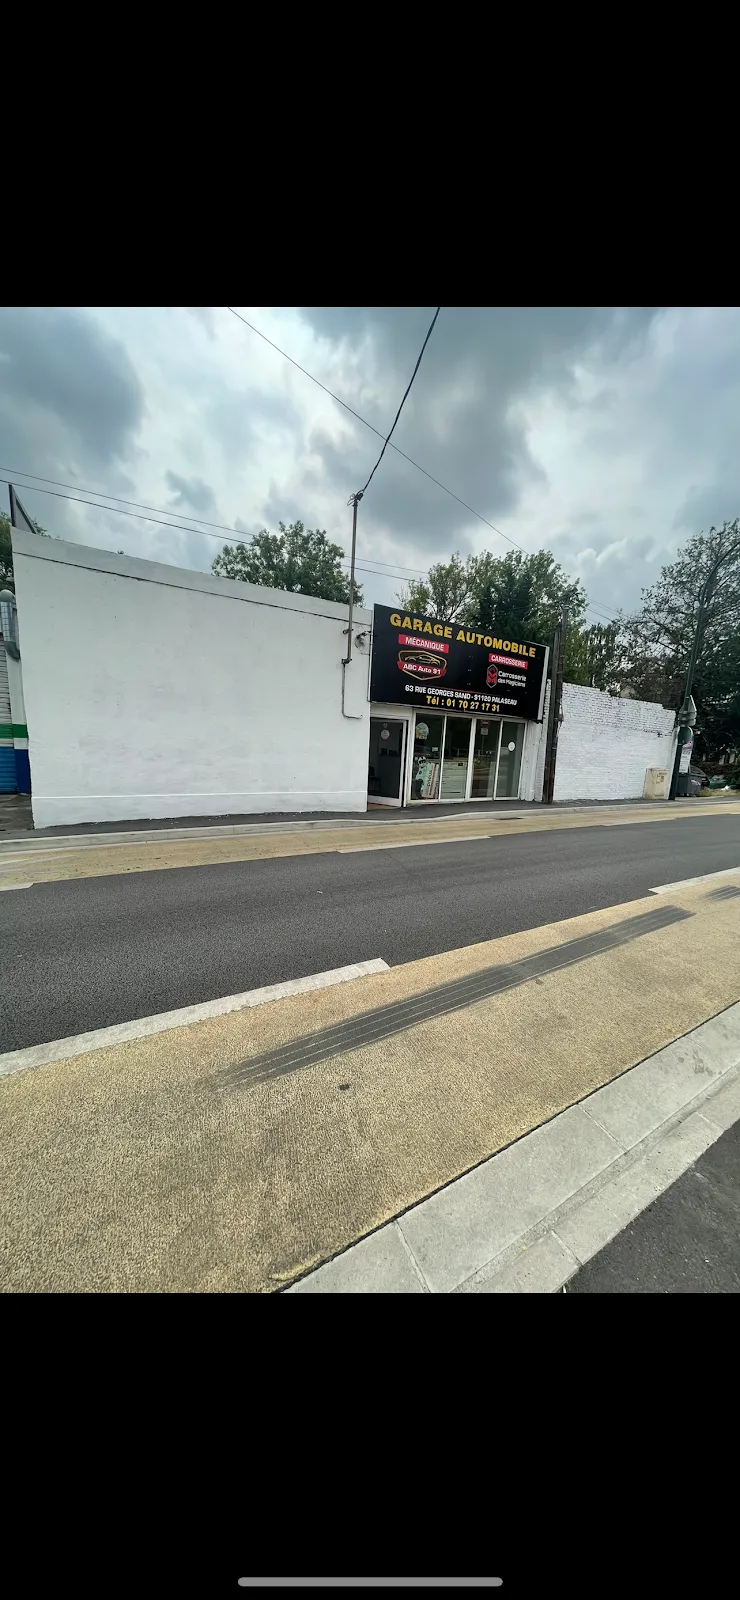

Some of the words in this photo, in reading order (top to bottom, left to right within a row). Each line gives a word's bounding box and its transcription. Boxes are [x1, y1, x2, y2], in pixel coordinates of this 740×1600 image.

[390, 613, 453, 639] GARAGE
[456, 630, 536, 658] AUTOMOBILE
[405, 636, 444, 651] MÉCANIQUE
[403, 663, 417, 671] ABC
[491, 654, 526, 668] CARROSSERIE
[498, 671, 526, 681] Carrosserie
[414, 685, 427, 694] RUE
[428, 687, 453, 697] GEORGES
[455, 691, 470, 699] SAND
[492, 697, 517, 705] PALASEAU
[426, 696, 439, 705] Tél
[446, 699, 455, 707] 01
[458, 700, 468, 708] 70
[470, 702, 479, 710] 27
[481, 703, 490, 711] 17
[491, 704, 500, 712] 31
